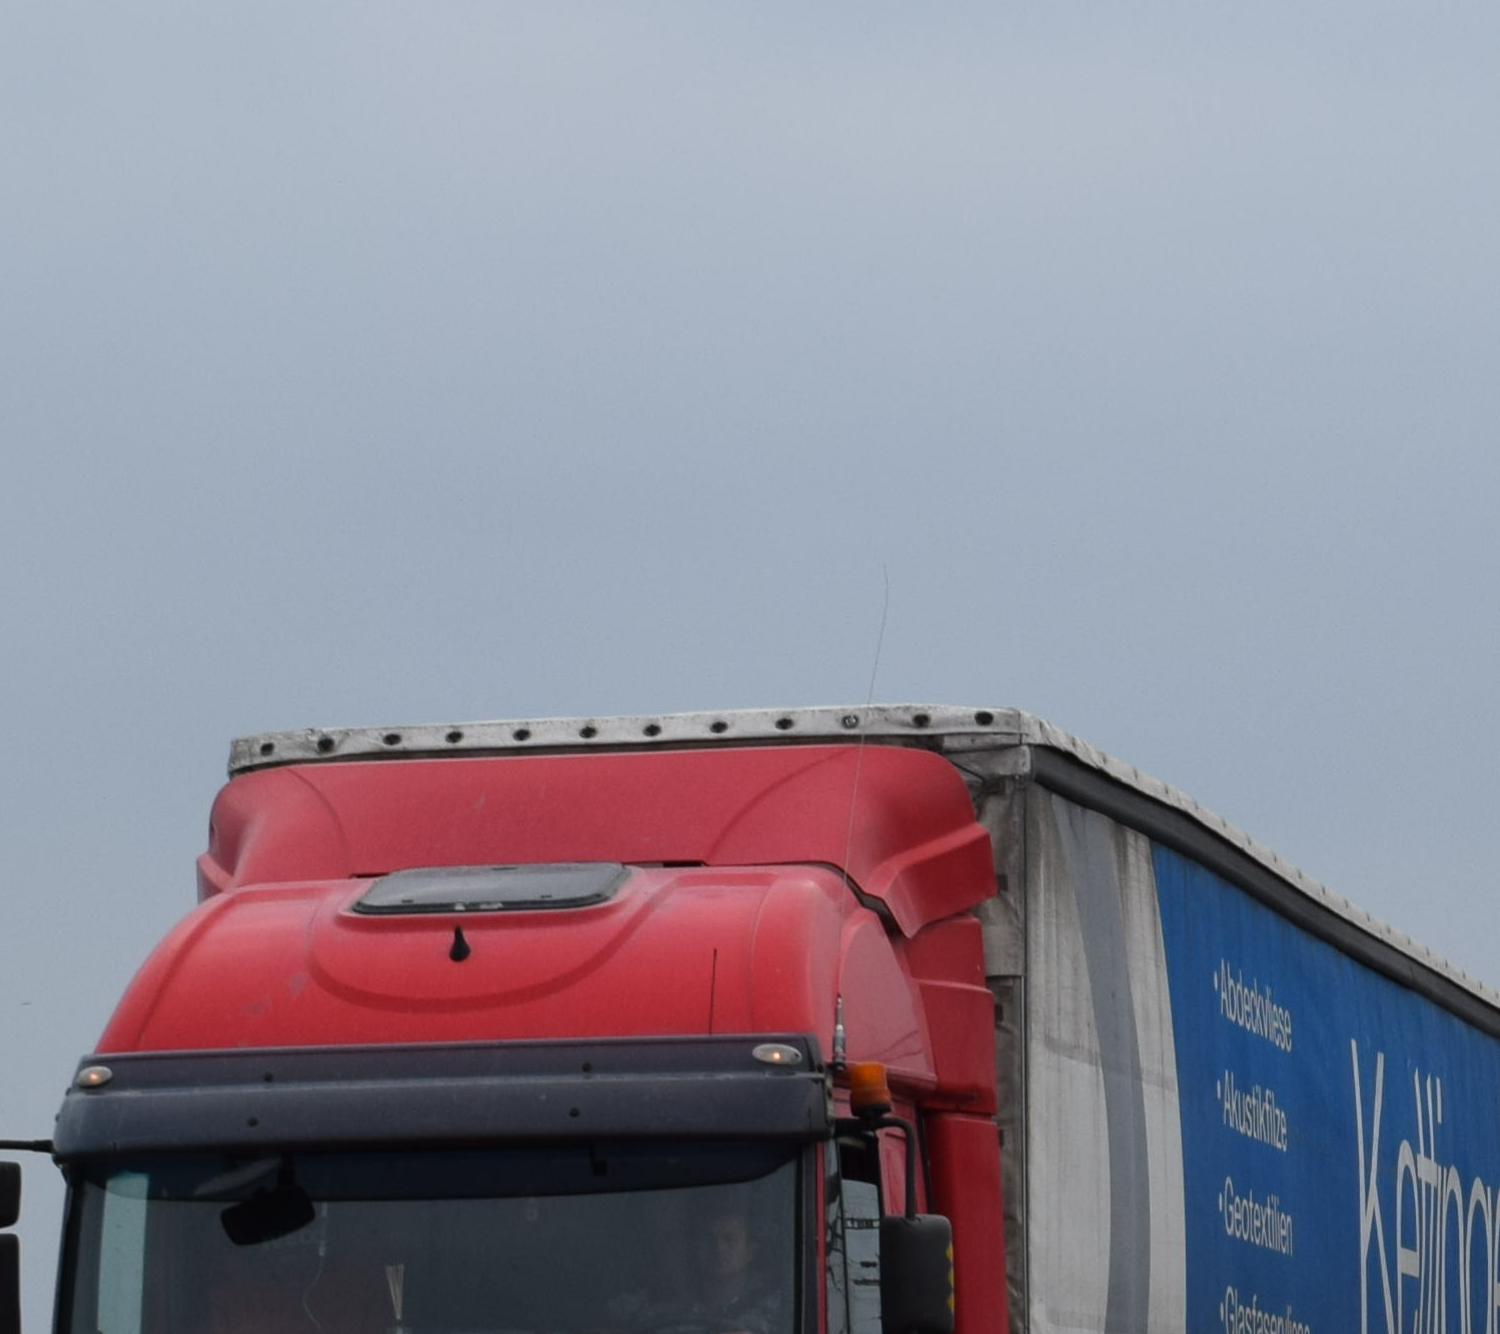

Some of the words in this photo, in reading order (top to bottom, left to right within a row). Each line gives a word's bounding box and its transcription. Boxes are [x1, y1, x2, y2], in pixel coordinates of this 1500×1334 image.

[1220, 957, 1293, 1052] Abdeckvliese
[1223, 1069, 1288, 1153] Akustikfilze
[1223, 1176, 1293, 1257] Geotextilien
